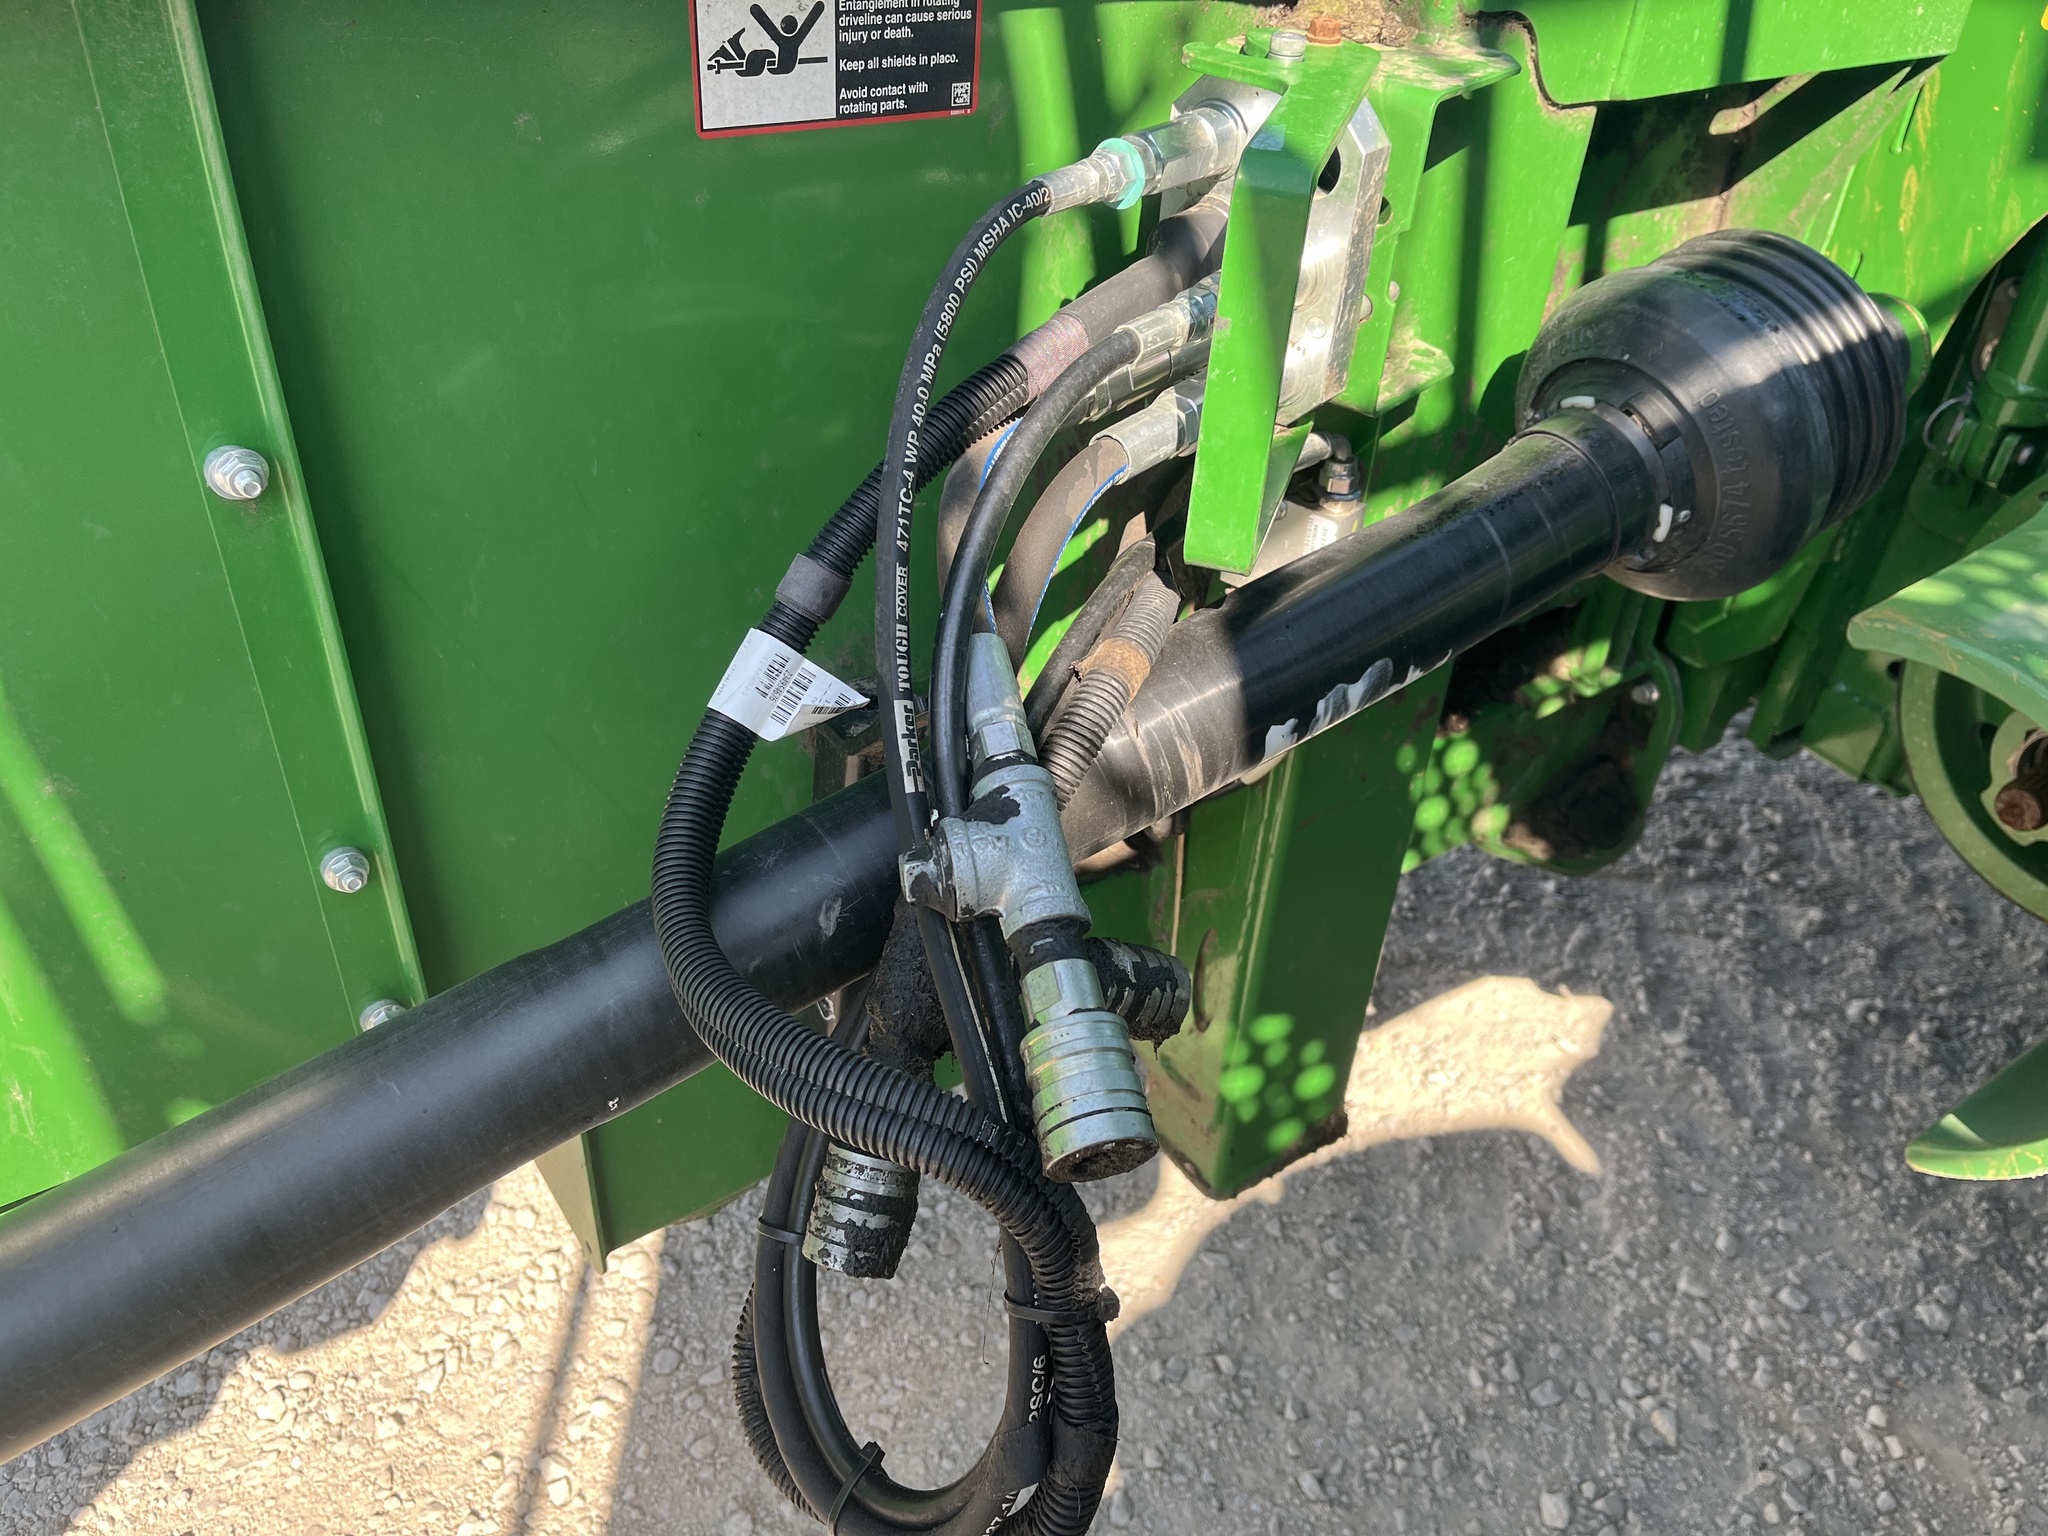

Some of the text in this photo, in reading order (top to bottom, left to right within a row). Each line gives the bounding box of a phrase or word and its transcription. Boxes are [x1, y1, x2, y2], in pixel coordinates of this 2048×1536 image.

[839, 0, 909, 12] Entanglement
[839, 8, 972, 26] driveline can cause serious
[839, 26, 914, 44] injury or death.
[839, 58, 865, 73] Keep
[867, 56, 879, 69] all
[881, 54, 917, 68] shields
[919, 53, 928, 65] in
[839, 81, 928, 100] Avoid contact with
[839, 98, 908, 115] rotating parts.
[973, 217, 1011, 262] MSHA
[954, 257, 978, 294] PSI)
[933, 293, 960, 342] (5800
[920, 343, 943, 384] MPa
[913, 386, 930, 428] 40.0
[904, 430, 920, 463] WP
[896, 469, 915, 553] 471TC-4
[896, 564, 909, 618] COVER
[895, 620, 911, 692] TOUGH
[901, 704, 924, 791] Parker
